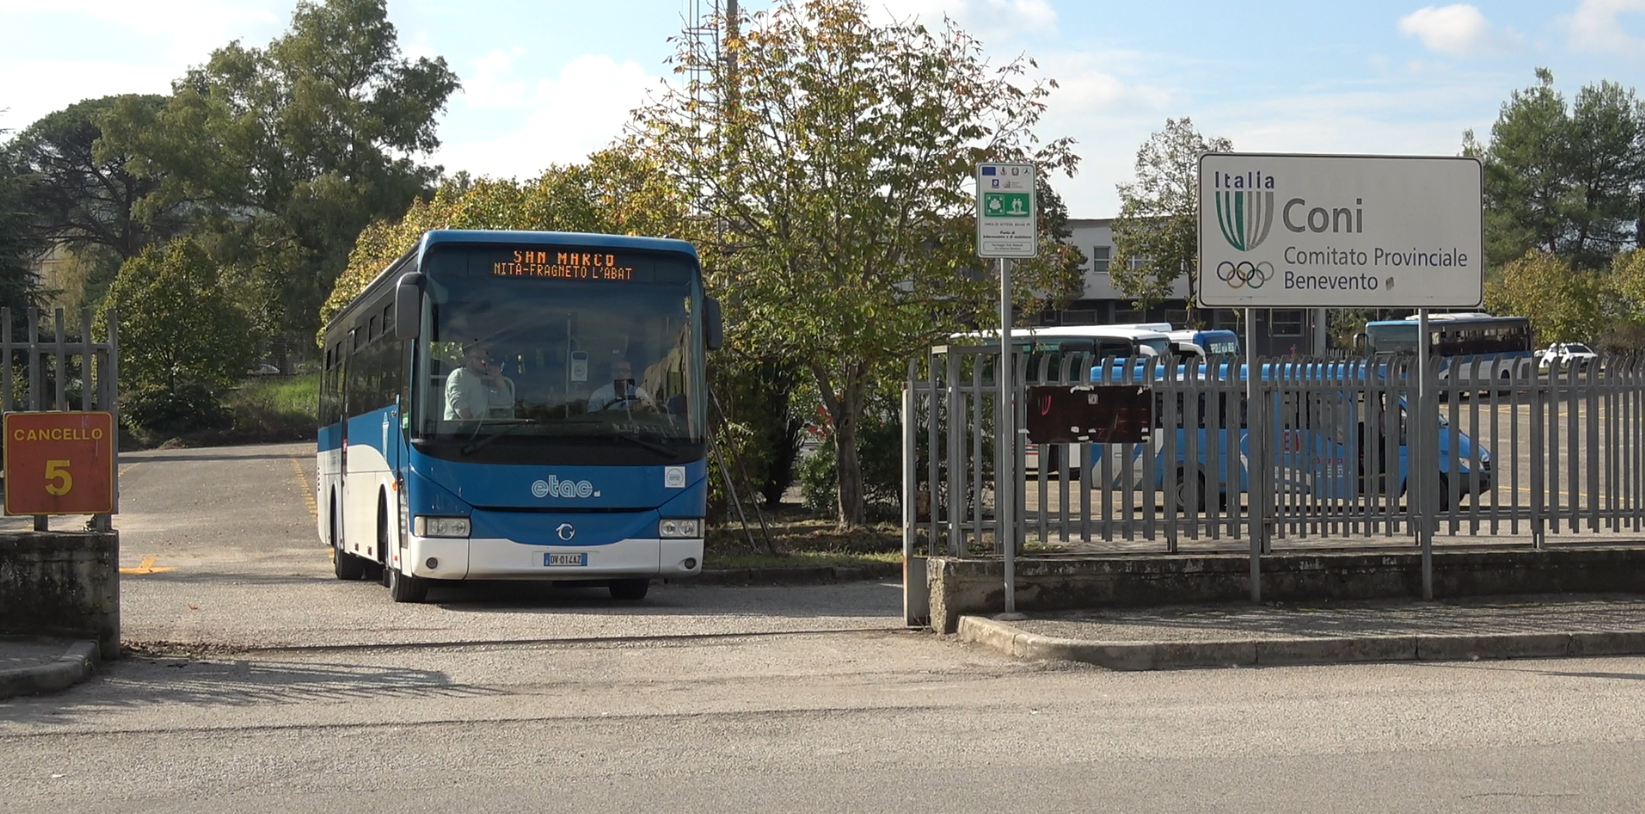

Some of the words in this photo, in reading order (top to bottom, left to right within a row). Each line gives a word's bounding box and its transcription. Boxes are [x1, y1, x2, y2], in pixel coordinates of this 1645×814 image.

[1215, 170, 1275, 189] Italia
[1282, 197, 1363, 233] Coni
[513, 250, 547, 264] SAN
[557, 252, 615, 267] MARCO
[1283, 246, 1368, 266] Comitato
[1374, 247, 1468, 268] Provinciale
[592, 267, 632, 280] L'ABAT
[1284, 271, 1378, 290] Benevento
[13, 428, 103, 441] CANCELLO
[44, 459, 73, 496] 5
[531, 474, 593, 498] etac
